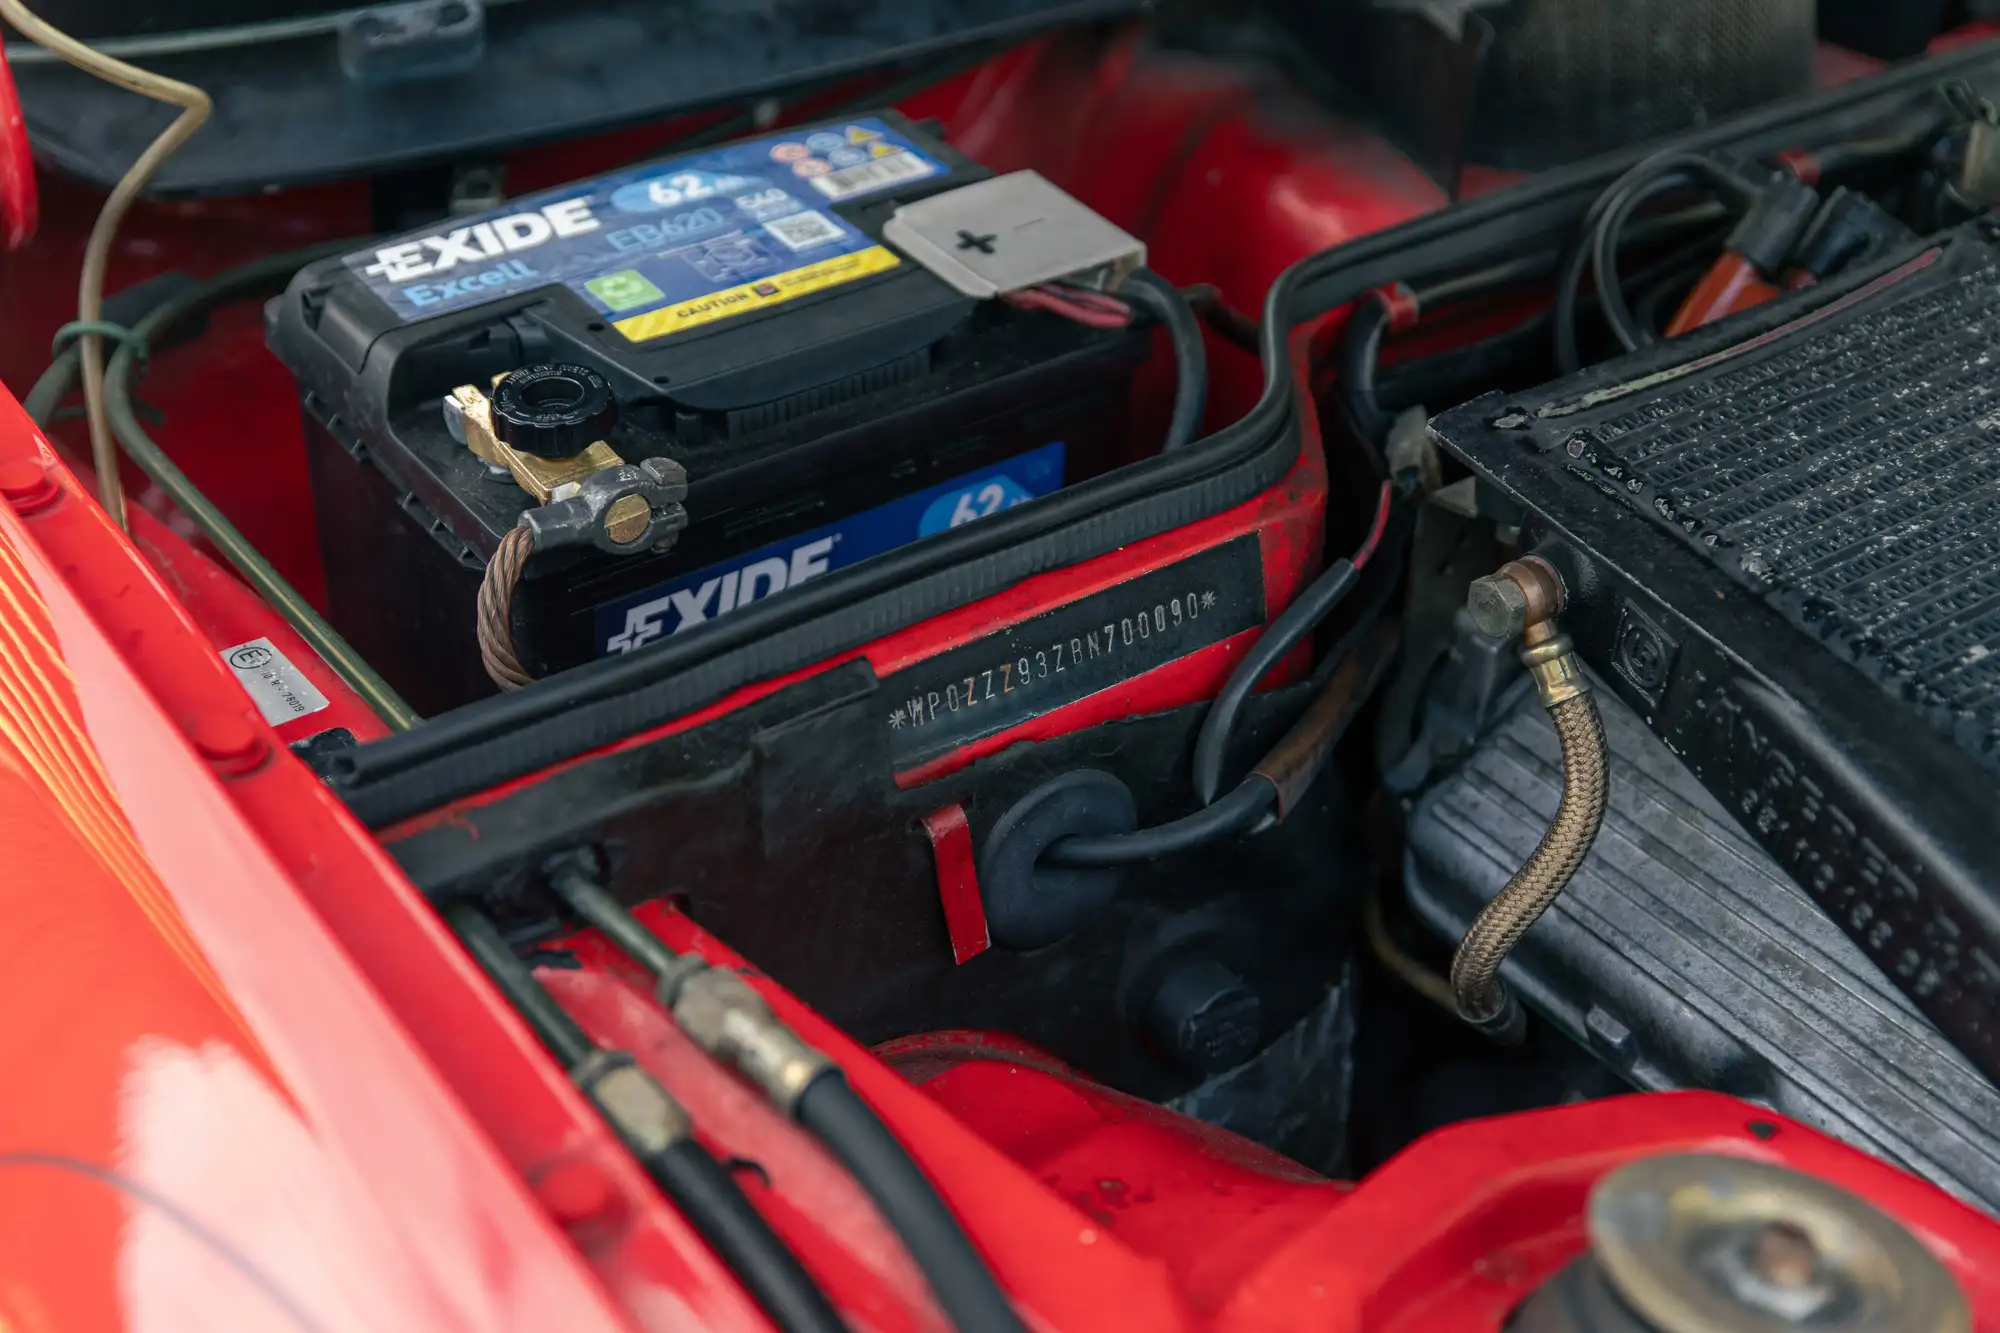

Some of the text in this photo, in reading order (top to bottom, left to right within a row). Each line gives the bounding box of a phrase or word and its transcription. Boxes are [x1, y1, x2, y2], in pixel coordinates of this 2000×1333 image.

[649, 174, 714, 207] 62
[365, 198, 600, 283] EXIDE
[605, 207, 724, 251] EB620
[402, 258, 540, 307] Excell
[676, 292, 748, 318] CAUTION
